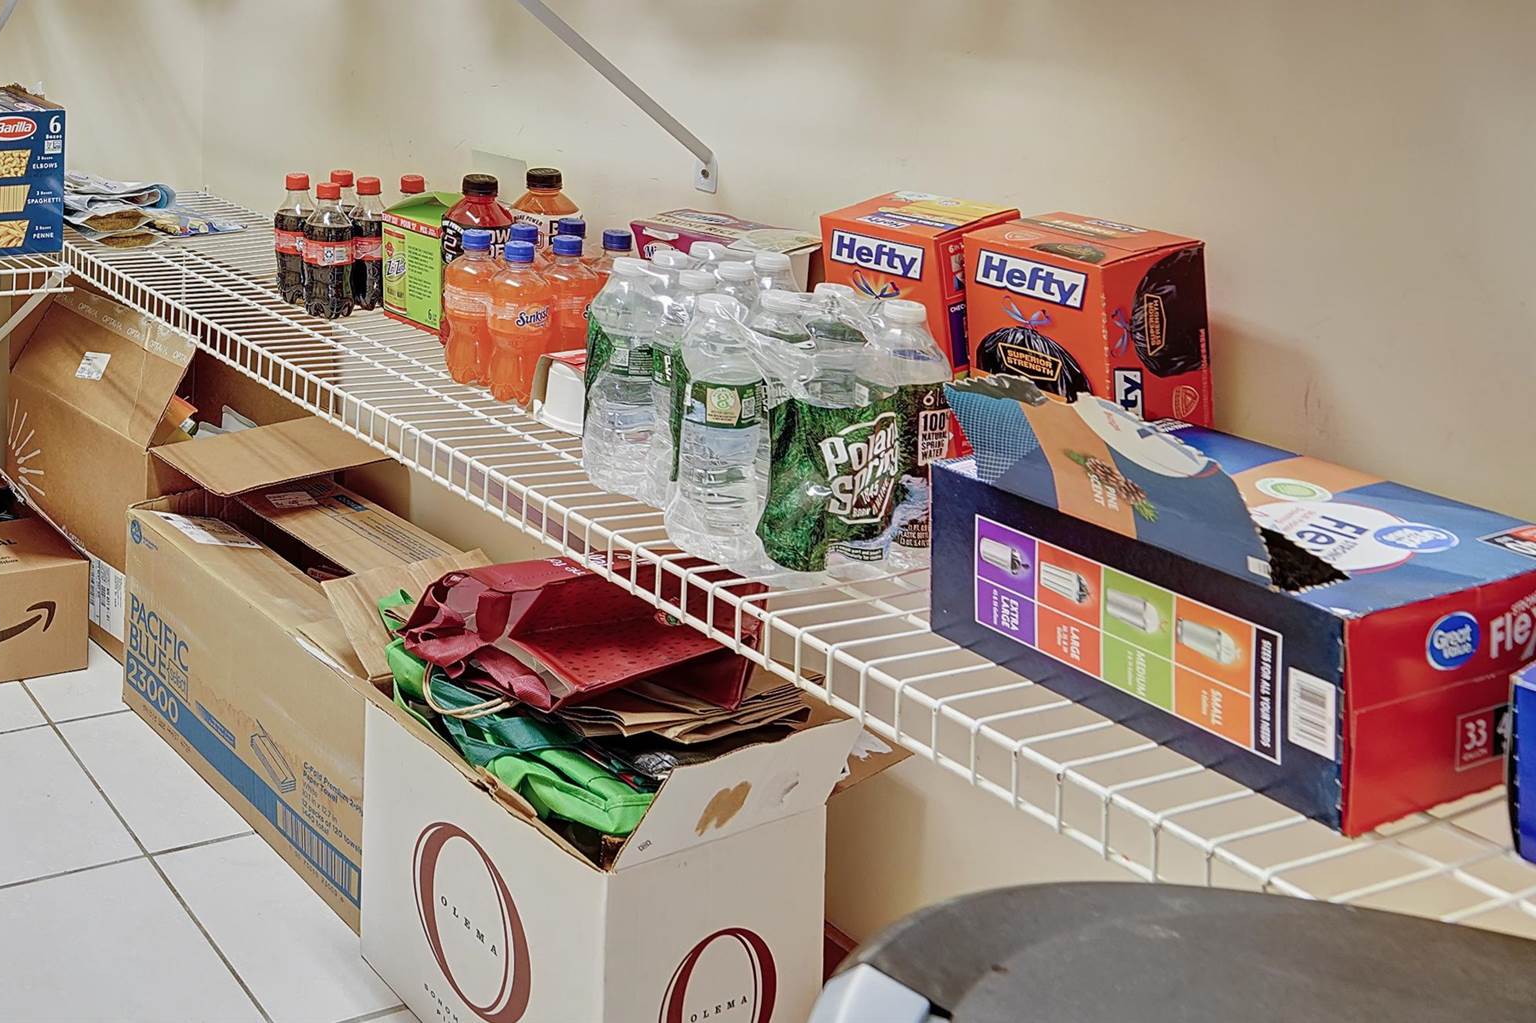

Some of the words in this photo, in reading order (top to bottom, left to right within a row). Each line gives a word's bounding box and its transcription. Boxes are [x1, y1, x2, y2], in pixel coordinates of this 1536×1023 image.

[49, 114, 63, 134] 6
[32, 162, 59, 170] ELBOWS
[27, 197, 62, 205] SPAGHETTI
[33, 232, 55, 240] PENNE
[835, 233, 918, 277] Hefty
[983, 254, 1080, 305] Hefty
[1146, 301, 1155, 346] SUPERIOR
[1007, 349, 1052, 368] SUPERIOR
[1007, 356, 1055, 377] STRENGTH
[818, 422, 898, 480] Poland
[921, 431, 948, 442] NATURAL
[921, 440, 945, 451] SPRING
[1104, 484, 1120, 512] PINE
[1000, 594, 1012, 630] LARGE
[1009, 598, 1020, 632] EXTRA
[128, 590, 190, 673] PACIFIC
[1069, 626, 1081, 662] LARGE
[1433, 624, 1473, 650] Great
[128, 619, 168, 682] BLUE
[1135, 648, 1147, 698] MEDIUM
[127, 657, 180, 725] 23000
[1210, 688, 1224, 726] SMALL
[1464, 719, 1488, 752] 33
[440, 894, 500, 958] OLEMA
[689, 995, 749, 1023] OLEMA
